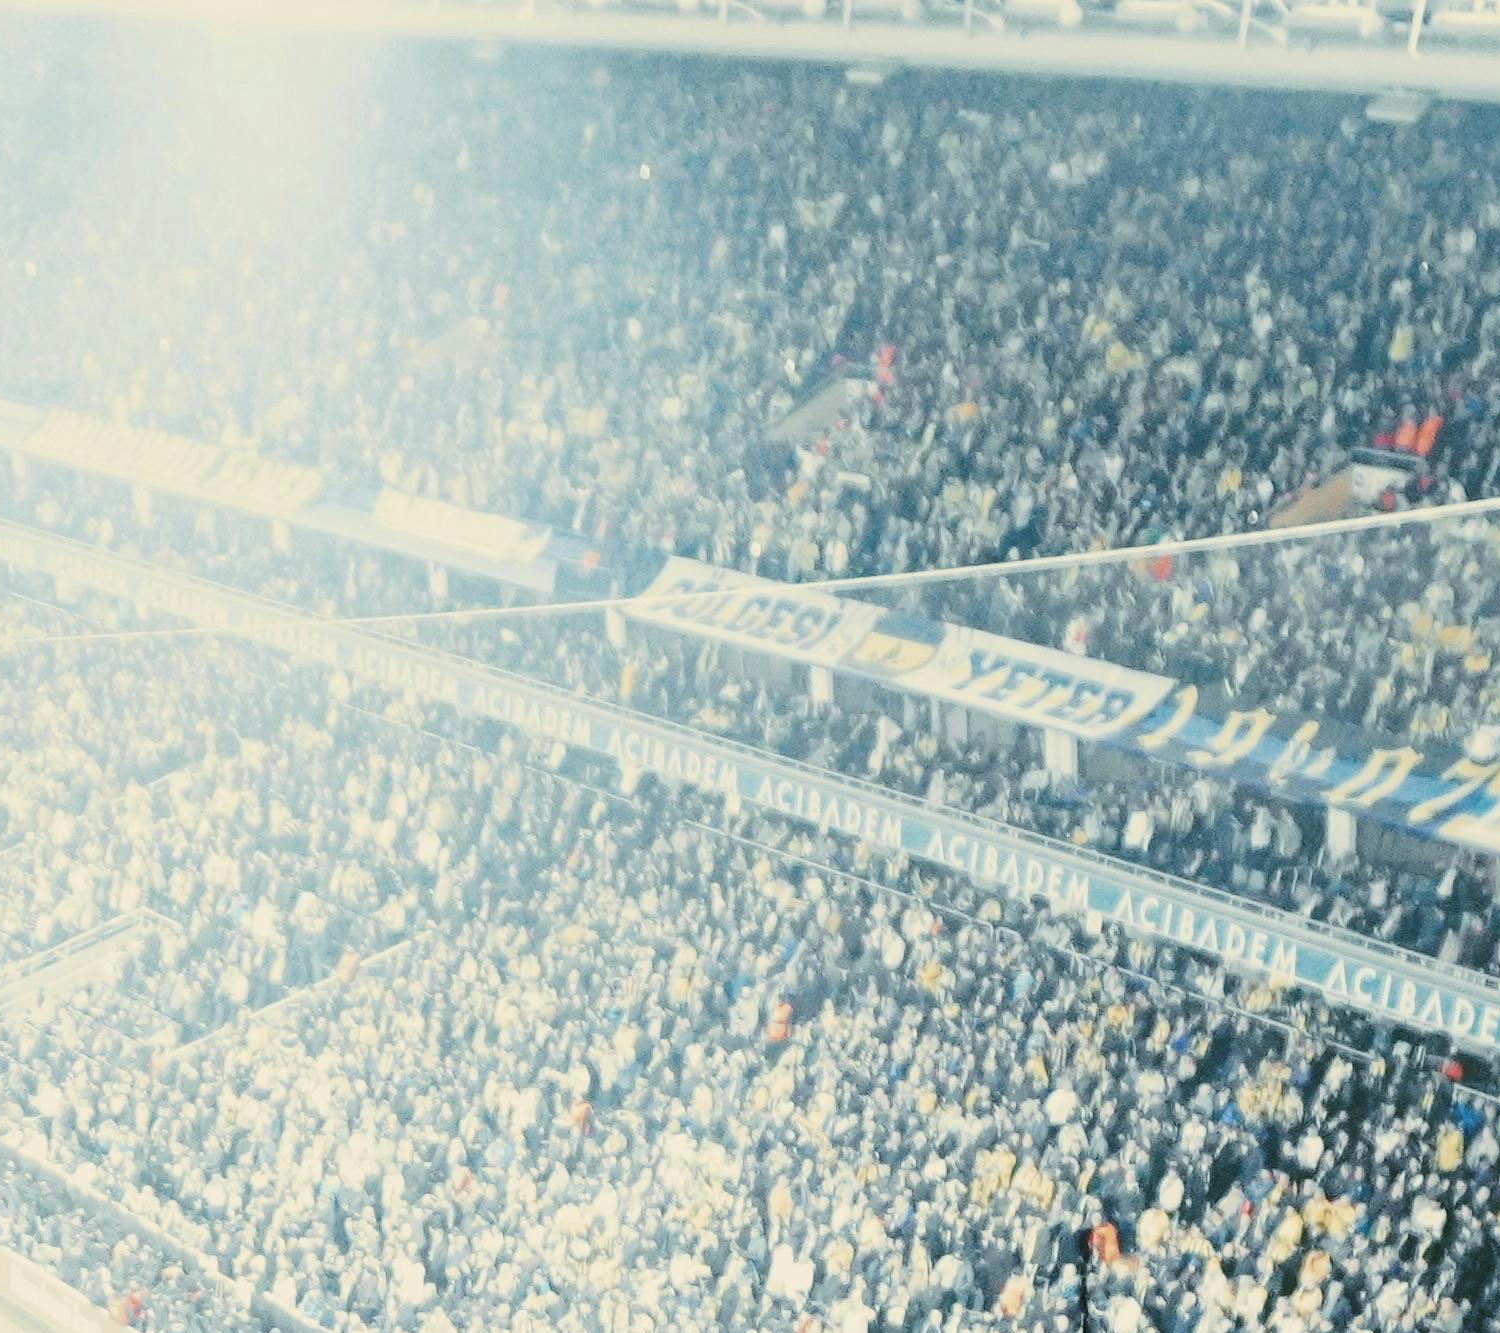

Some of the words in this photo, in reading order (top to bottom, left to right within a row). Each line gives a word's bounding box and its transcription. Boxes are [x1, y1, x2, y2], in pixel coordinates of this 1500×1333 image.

[472, 685, 590, 747] ACIBADEM
[950, 649, 1137, 723] YETER
[606, 728, 738, 793] ACIBADEM
[756, 775, 902, 846] ACIBADEM
[926, 828, 1090, 908] ACIBADEM
[1112, 889, 1298, 978] ACIBADEM
